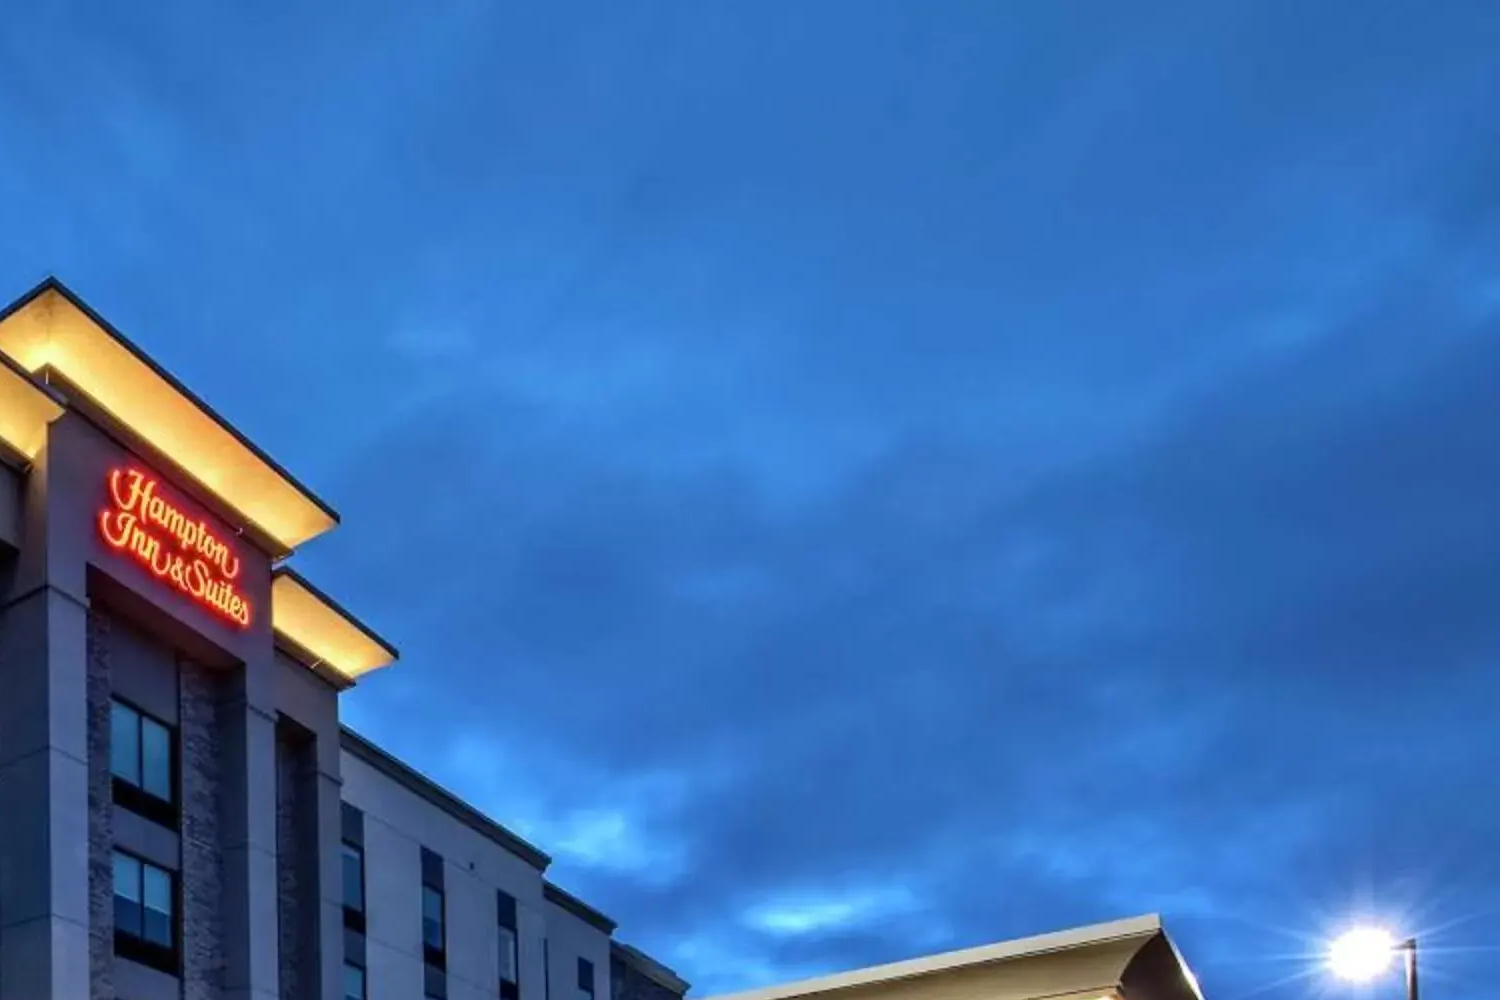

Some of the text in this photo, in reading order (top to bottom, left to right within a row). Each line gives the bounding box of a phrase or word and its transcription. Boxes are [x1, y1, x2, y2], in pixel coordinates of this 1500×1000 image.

[101, 510, 249, 625] Inn & Suites
[111, 469, 240, 579] Hampton
